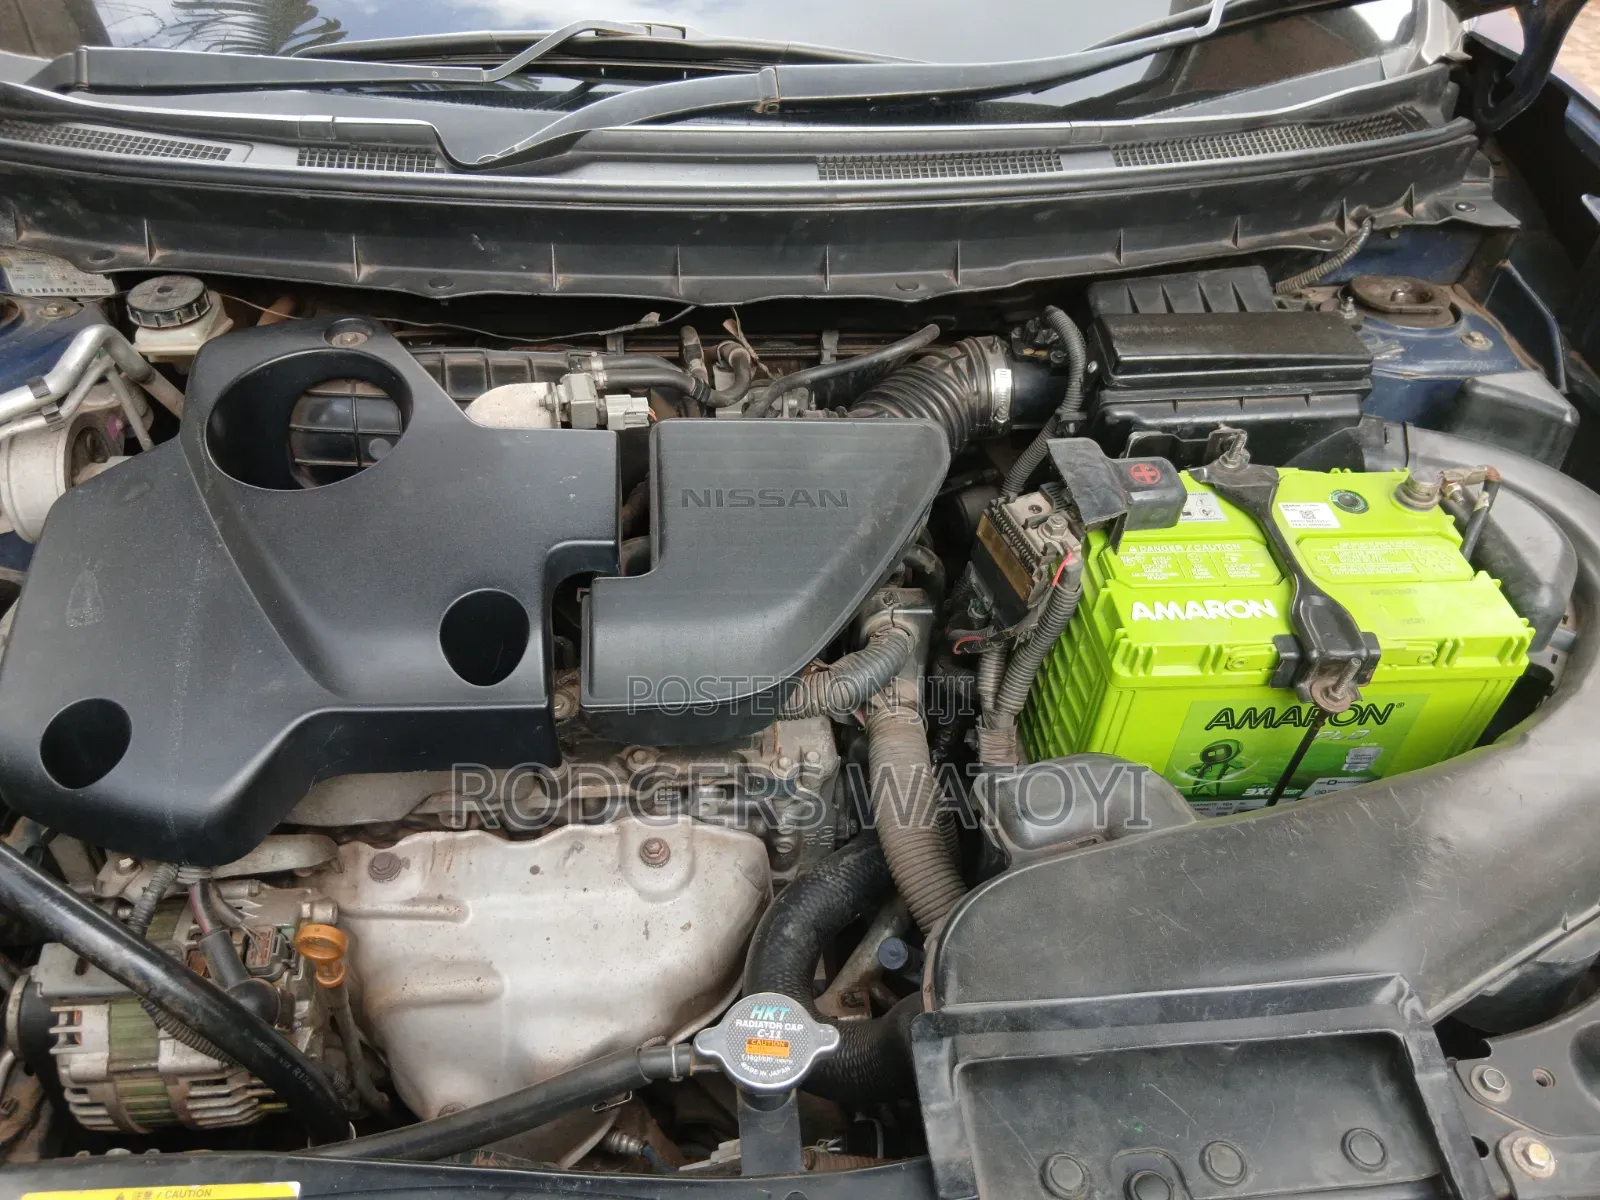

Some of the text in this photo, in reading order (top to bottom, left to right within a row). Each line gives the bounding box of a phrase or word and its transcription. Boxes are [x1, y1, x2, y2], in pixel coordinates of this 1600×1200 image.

[681, 489, 849, 508] NISSAN
[1140, 544, 1183, 552] DANGER
[1194, 543, 1241, 551] CAUTION
[1131, 598, 1278, 621] AMARON
[750, 1003, 790, 1021] HKT
[735, 1019, 804, 1031] RADIATOR CAP
[757, 1029, 782, 1039] C-11
[751, 1039, 785, 1047] CAUTION
[768, 1065, 791, 1077] JAPAN
[165, 1188, 213, 1199] CAUTION
